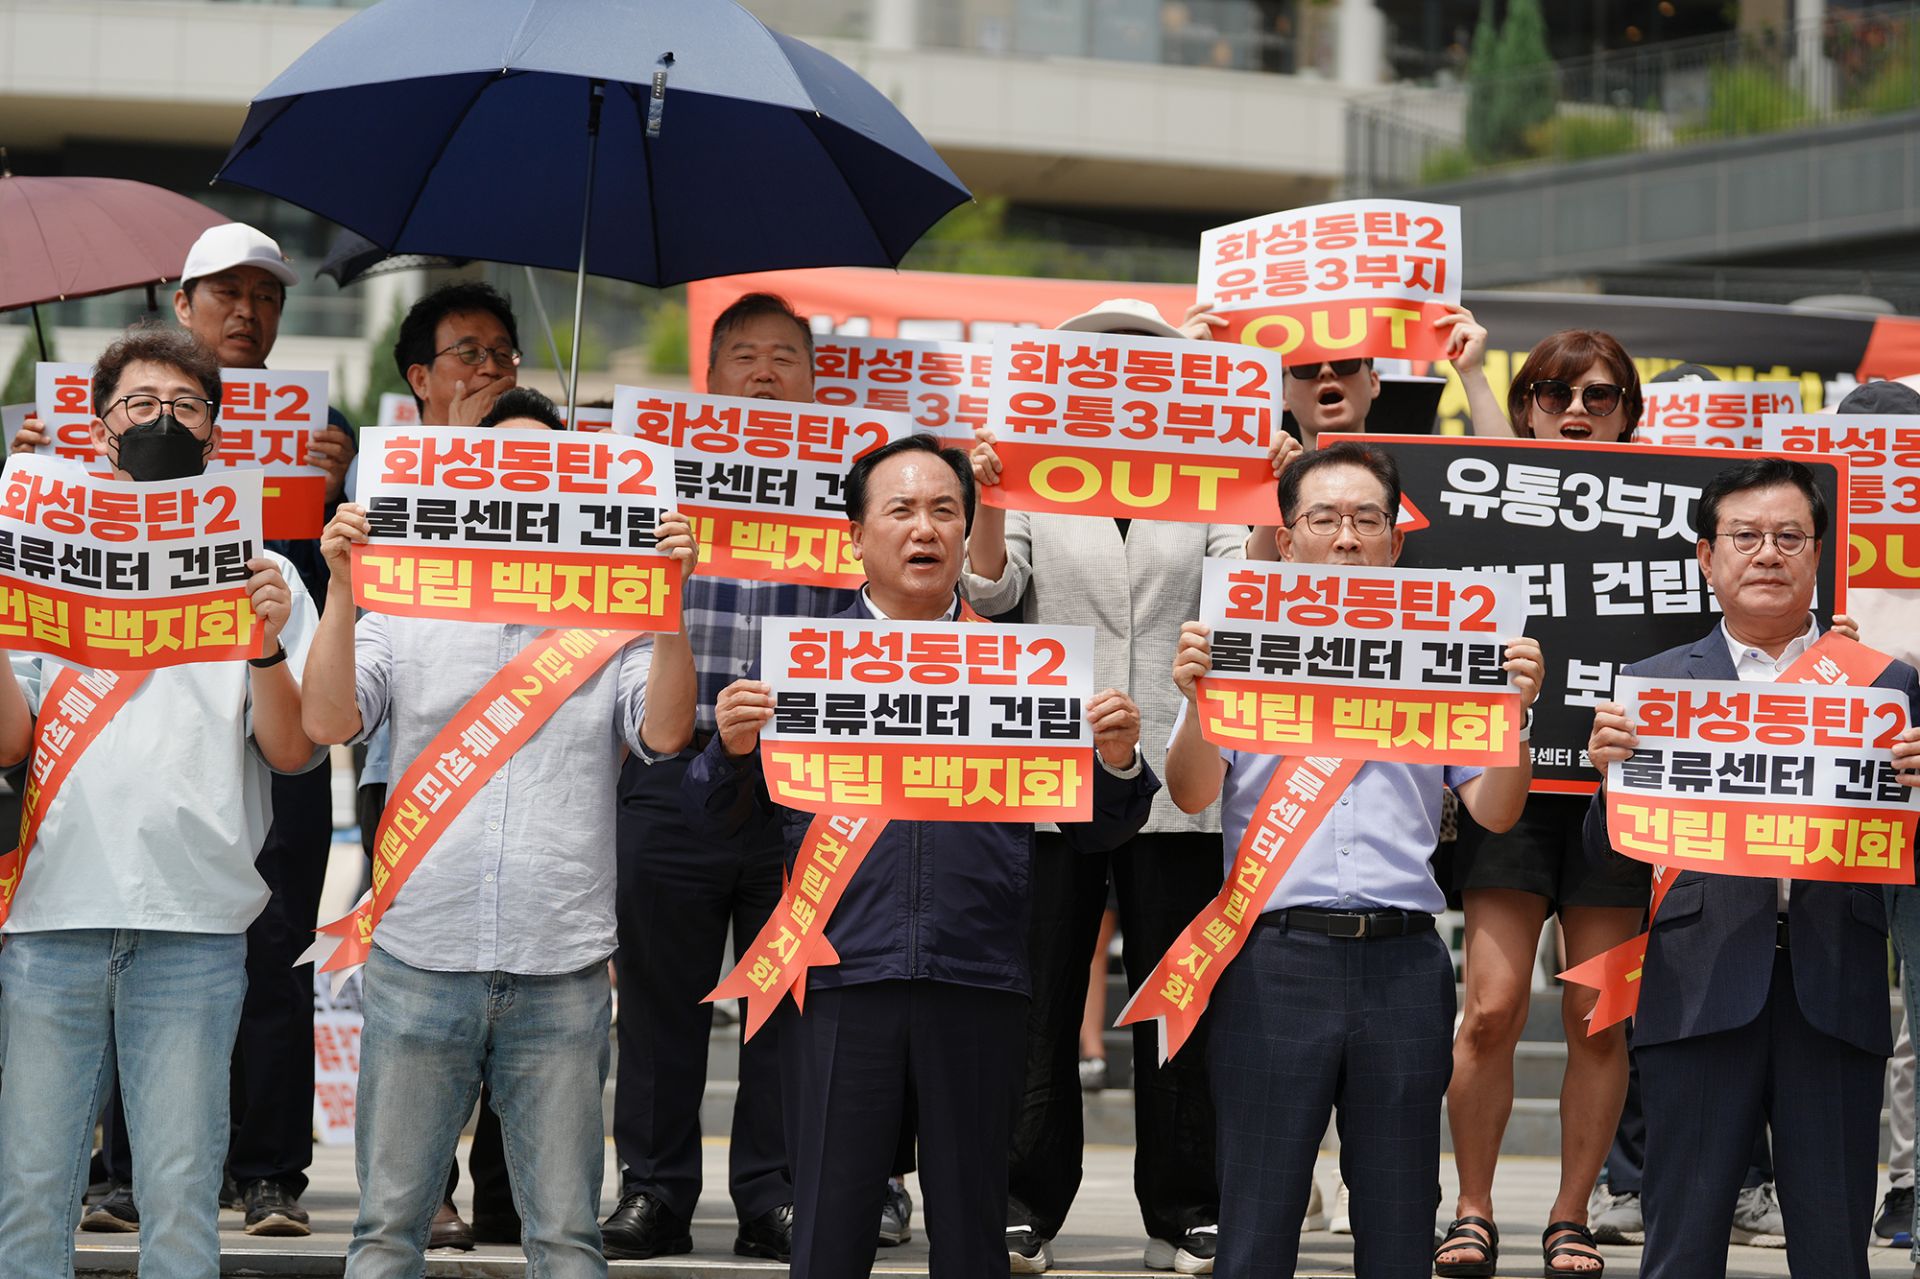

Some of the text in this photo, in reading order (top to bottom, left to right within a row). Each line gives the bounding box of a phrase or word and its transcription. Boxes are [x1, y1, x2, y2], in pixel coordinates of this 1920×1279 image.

[1215, 212, 1446, 266] 화성동탄2
[1214, 254, 1446, 303] 유통3부지
[1240, 307, 1421, 355] OUT
[1007, 341, 1271, 401] 화성동탄2
[634, 398, 889, 464] 화성동탄2
[1005, 391, 1271, 448] 유통3부지
[381, 436, 656, 496] 화성동탄2
[1028, 456, 1239, 511] OUT
[0, 470, 240, 542] 화성동탄2
[365, 497, 559, 543] 물류센터
[579, 504, 668, 548] 건립
[169, 540, 254, 589] 건립
[361, 555, 670, 616] 건립 백지화
[84, 597, 256, 658] 백지화
[1225, 569, 1497, 632] 화성동탄2
[788, 628, 1067, 686] 화성동탄2
[1210, 631, 1508, 686] 물류센터 건립
[774, 692, 1081, 740] 물류센터 건립
[1206, 689, 1509, 752] 건립 백지화
[1636, 688, 1907, 749] 화성동탄2
[772, 752, 1082, 807] 건립 백지화
[1621, 750, 1815, 796] 물류센터
[1617, 804, 1905, 868] 건립 백지화
